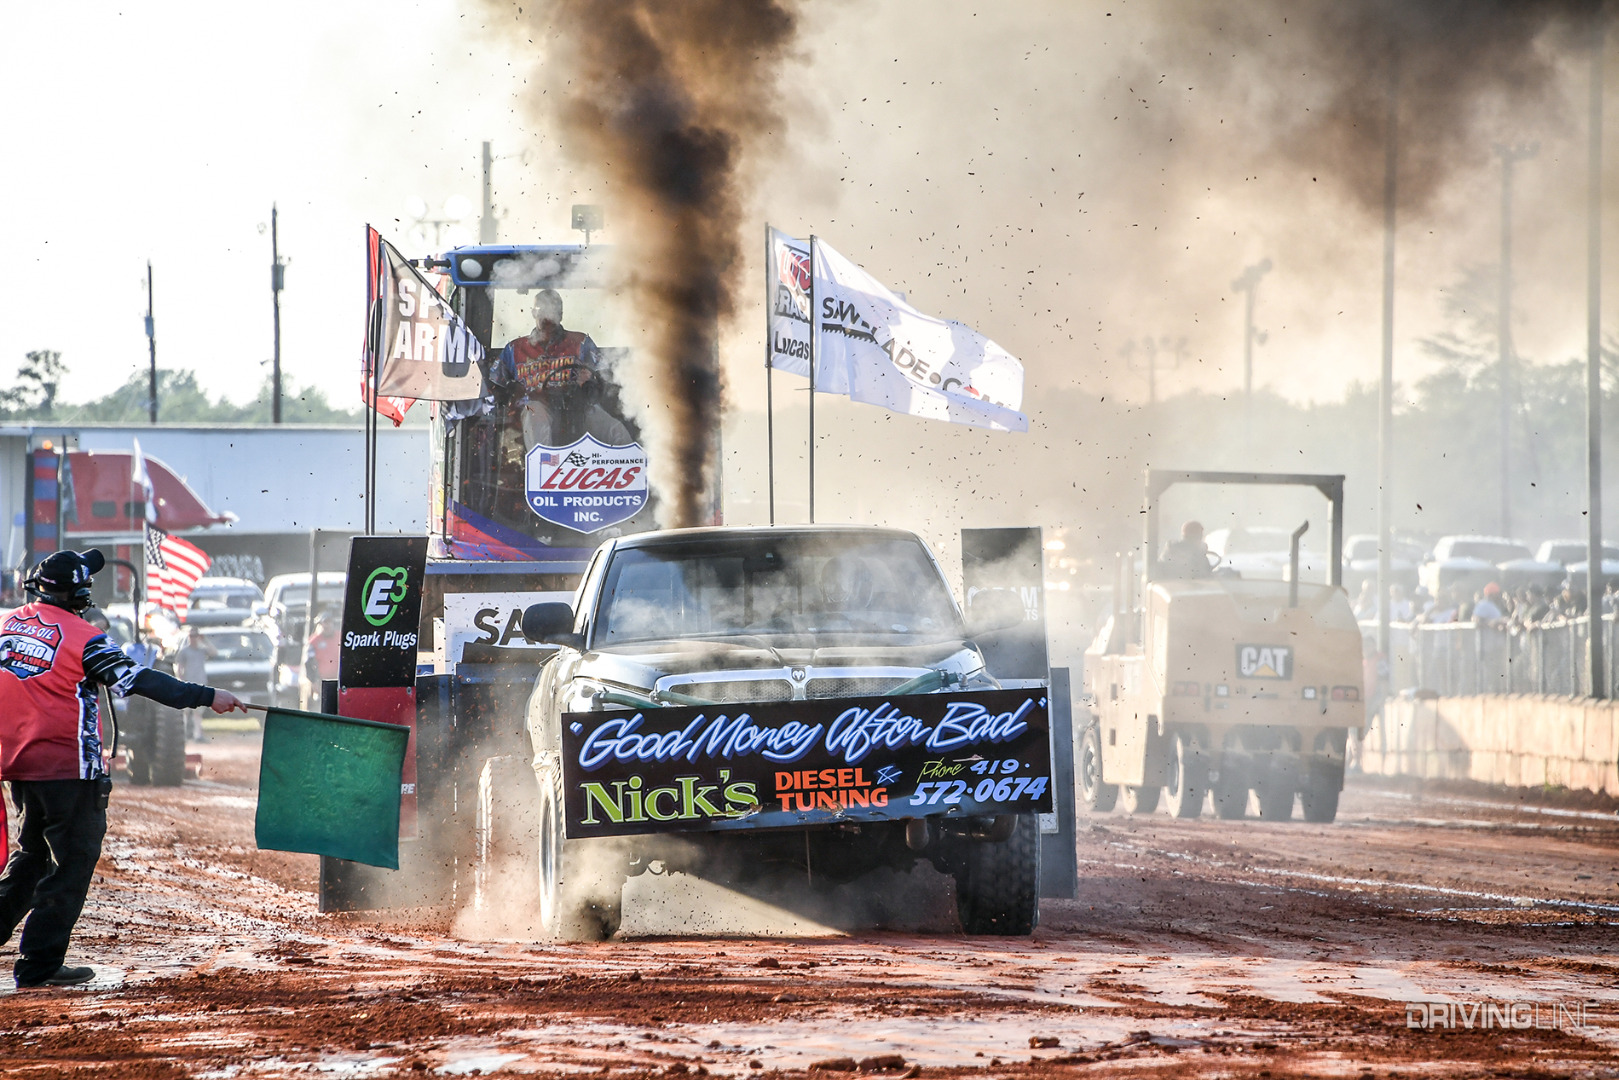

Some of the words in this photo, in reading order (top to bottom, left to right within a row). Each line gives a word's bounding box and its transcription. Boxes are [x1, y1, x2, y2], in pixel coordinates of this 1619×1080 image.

[394, 320, 486, 364] ARMO
[774, 331, 810, 360] Lucas
[540, 466, 641, 490] LUCAS
[533, 496, 559, 507] OIL
[563, 495, 642, 507] PRODUCTS
[574, 511, 604, 522] INC.
[4, 620, 38, 636] LUCAS
[36, 627, 56, 640] OIL
[474, 608, 537, 646] SA
[15, 641, 48, 659] PRO
[344, 630, 381, 651] Spark
[383, 630, 417, 650] Plugs
[1240, 646, 1289, 678] CAT
[687, 711, 823, 764] Money
[825, 701, 933, 764] After
[775, 767, 872, 792] DIESEL
[916, 756, 967, 784] Phone
[400, 783, 416, 795] RE
[580, 769, 760, 825] Nick's
[775, 787, 889, 814] TUNING
